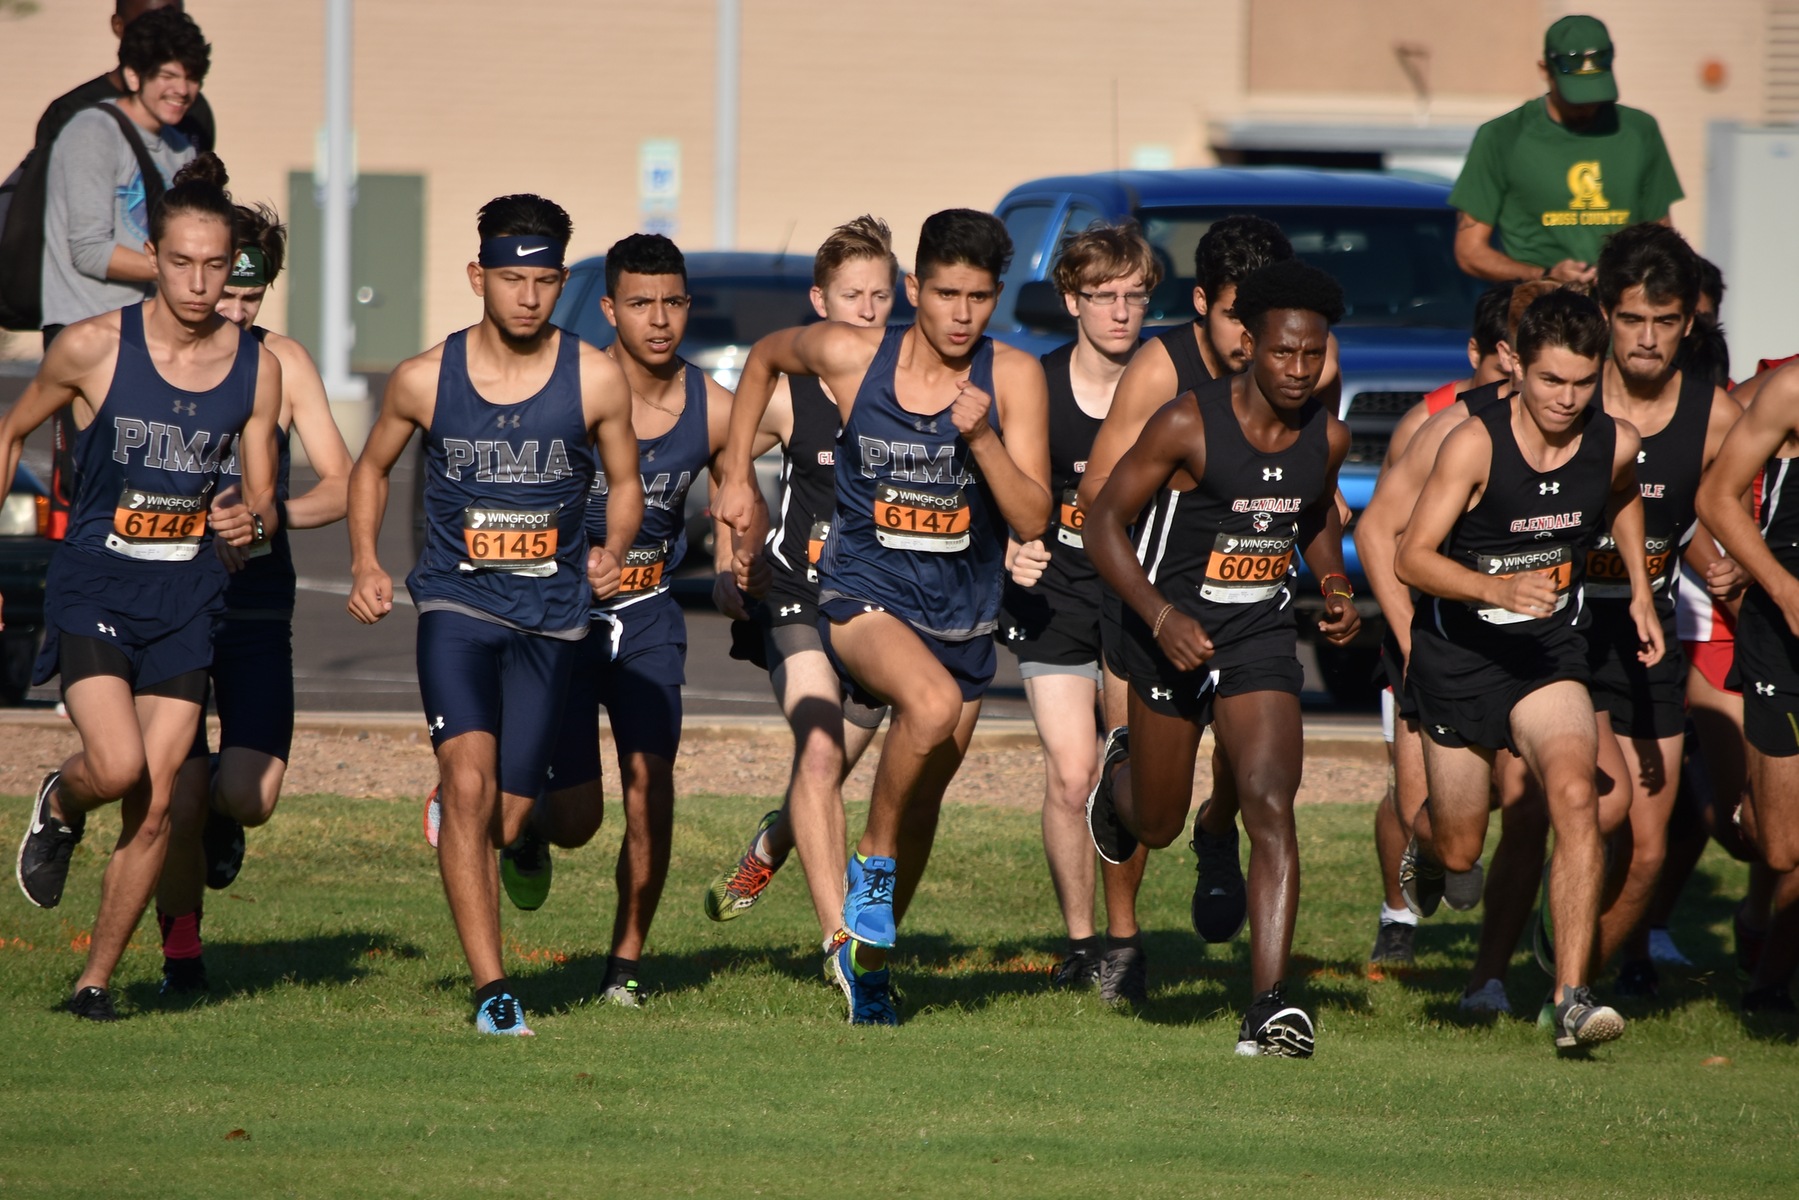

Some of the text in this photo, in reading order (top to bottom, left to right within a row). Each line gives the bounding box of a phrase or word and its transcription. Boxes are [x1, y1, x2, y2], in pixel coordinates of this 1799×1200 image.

[443, 438, 574, 483] PIMA
[899, 490, 958, 506] WINGFOOT
[1232, 498, 1301, 513] GLENDALE
[124, 512, 197, 537] 6146
[487, 513, 550, 524] WINGFOOT
[885, 505, 959, 533] 6147
[1510, 511, 1582, 532] GLENDALE
[472, 532, 548, 558] 6145
[1240, 538, 1293, 550] WINGFOO
[1218, 556, 1286, 580] 6096
[1503, 548, 1562, 567] WINGFOOT
[1590, 556, 1662, 577] 608
[622, 567, 655, 589] 48
